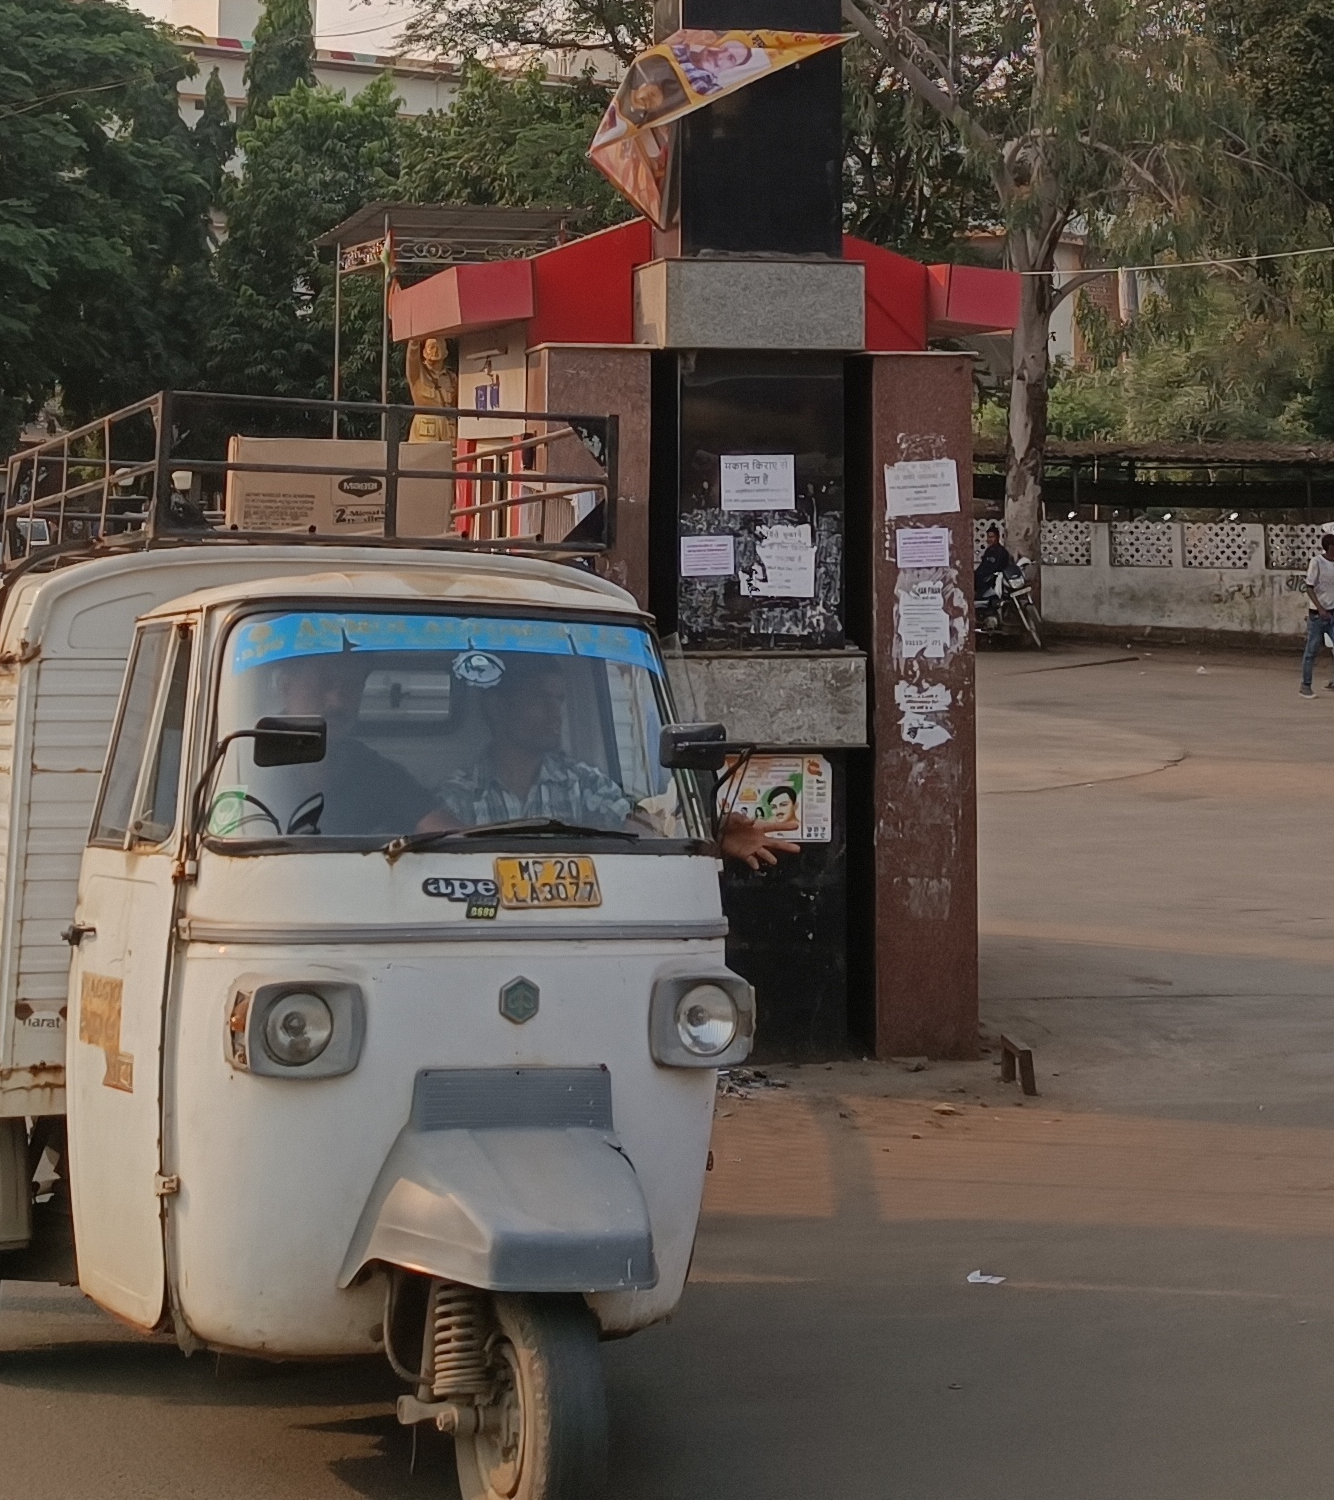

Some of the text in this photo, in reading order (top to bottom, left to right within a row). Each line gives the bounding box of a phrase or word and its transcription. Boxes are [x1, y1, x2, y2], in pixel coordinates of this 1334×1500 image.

[724, 461, 750, 470] मकान
[744, 473, 761, 485] देना
[519, 859, 581, 882] MP 20
[427, 879, 496, 899] ape
